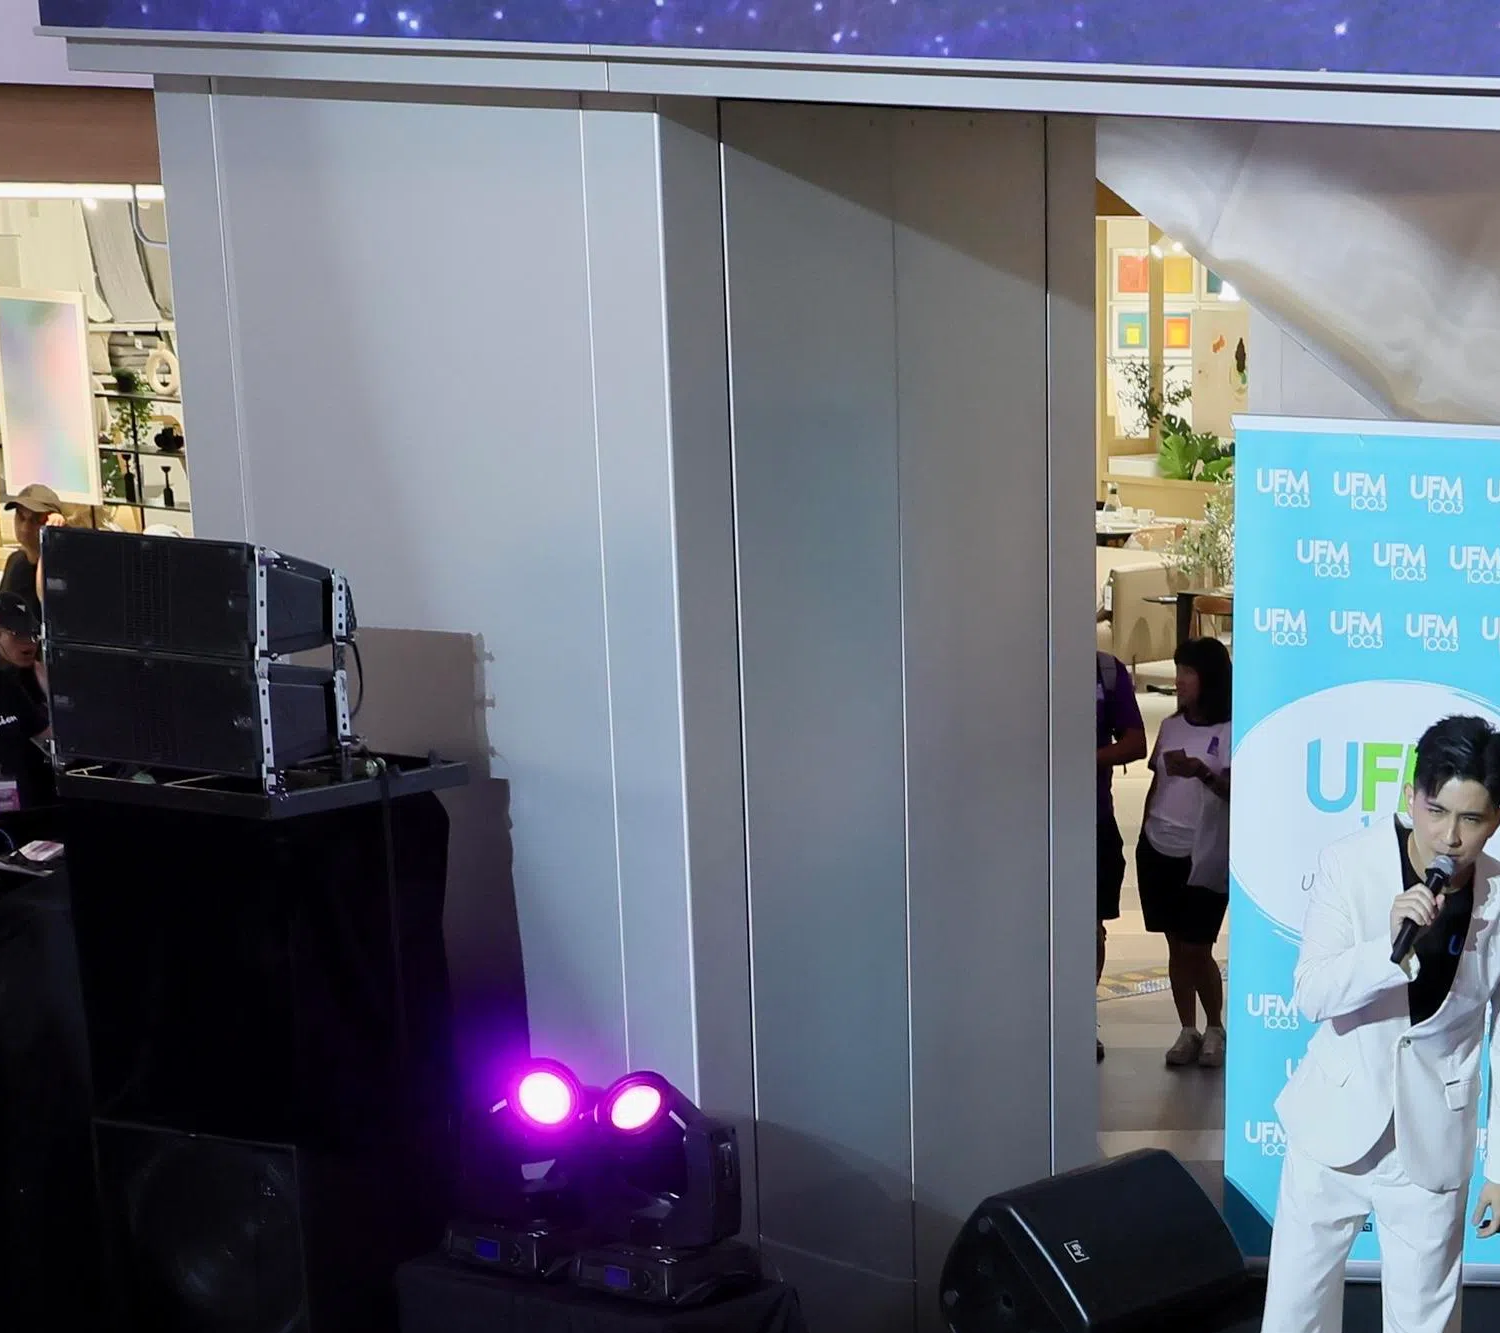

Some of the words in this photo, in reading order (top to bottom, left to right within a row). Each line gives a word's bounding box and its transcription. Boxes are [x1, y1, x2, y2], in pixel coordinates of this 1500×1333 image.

[1256, 468, 1309, 495] UFM
[1333, 471, 1386, 499] UFM
[1410, 474, 1463, 502] UFM
[1296, 539, 1349, 566] UFM
[1373, 542, 1426, 570] UFM
[1254, 607, 1307, 634] UFM
[1330, 610, 1383, 637] UFM
[1406, 613, 1459, 640] UFM
[1247, 993, 1299, 1018] UFM
